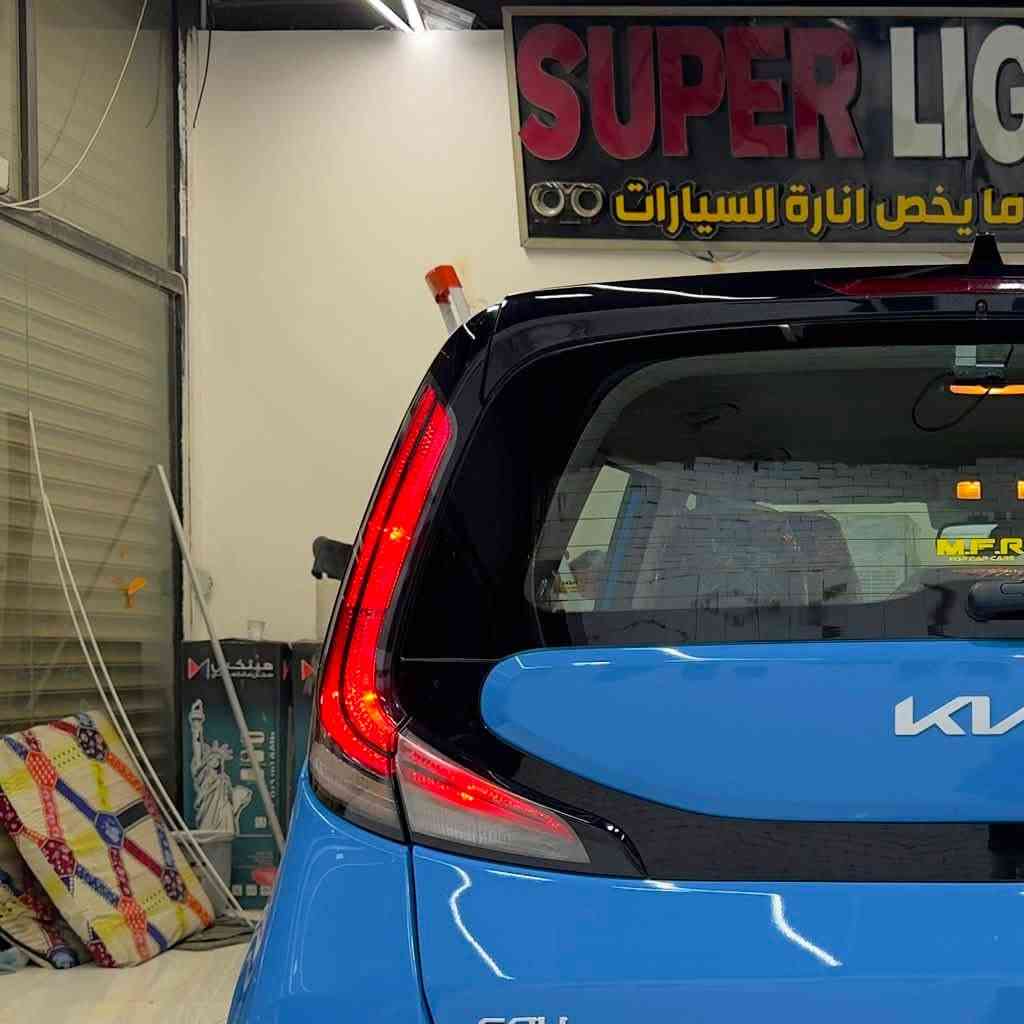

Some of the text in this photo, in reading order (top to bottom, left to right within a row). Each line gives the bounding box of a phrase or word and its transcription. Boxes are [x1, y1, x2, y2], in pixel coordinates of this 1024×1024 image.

[516, 22, 865, 161] SUPER
[614, 182, 776, 235] السيارات
[785, 183, 866, 236] انارة
